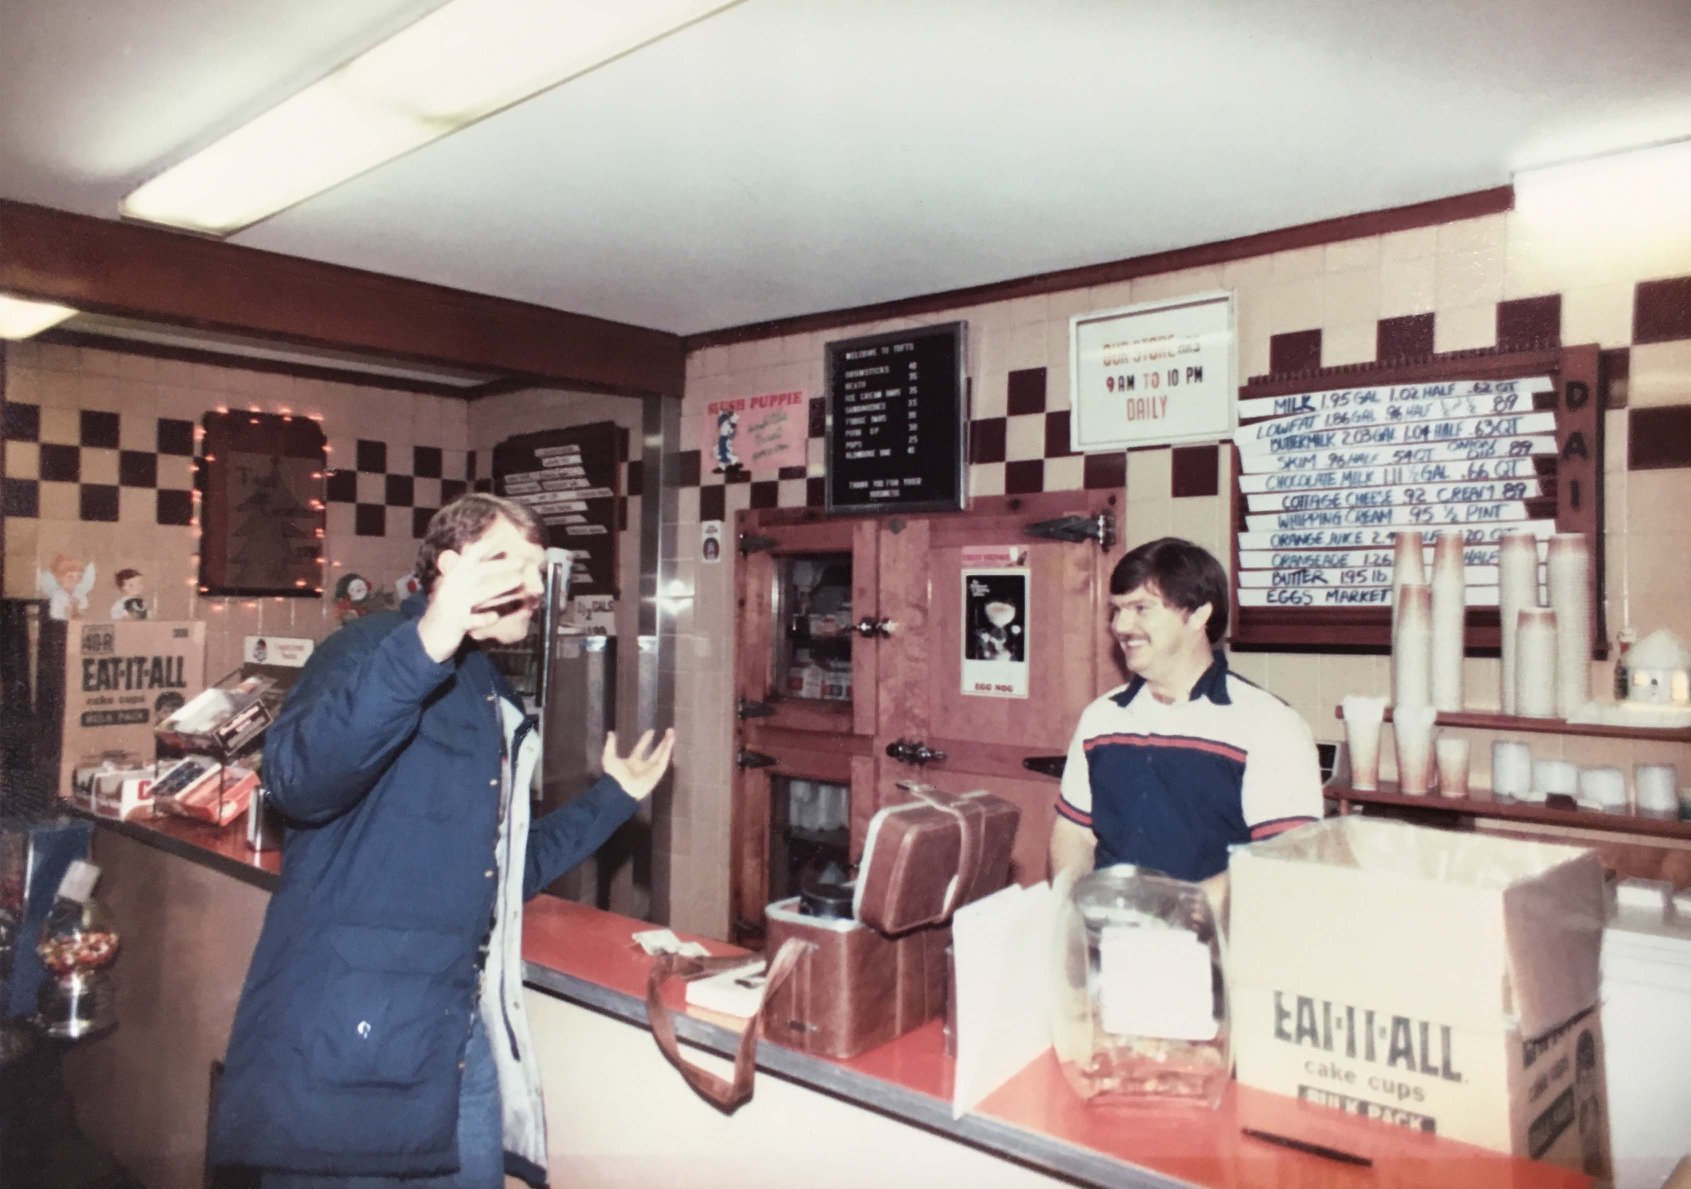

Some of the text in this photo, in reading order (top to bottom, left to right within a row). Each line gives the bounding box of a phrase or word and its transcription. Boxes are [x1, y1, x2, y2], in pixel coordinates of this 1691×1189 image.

[1143, 371, 1160, 389] TO
[1167, 369, 1179, 387] 10
[1186, 366, 1203, 384] PM
[750, 391, 802, 410] PUPPIE
[1127, 395, 1168, 421] DAILY
[1274, 395, 1315, 414] MILK
[1423, 383, 1456, 399] HALF
[1256, 413, 1320, 440] LOWFAT
[1434, 421, 1464, 438] HALF
[1277, 453, 1316, 471] SKIM
[1266, 471, 1336, 491] CHOCOLATE
[1341, 470, 1373, 485] MILK
[1282, 493, 1341, 511] COTTAGE
[1345, 489, 1393, 506] CHEESE
[1437, 484, 1496, 503] CREAM
[1278, 513, 1342, 529] WHIPPING
[1345, 508, 1393, 525] CREAM
[1465, 503, 1508, 521] PINT
[1270, 531, 1324, 549] ORANGE
[1326, 532, 1363, 547] JUICE
[1272, 552, 1348, 568] ORANGEADE
[1272, 568, 1328, 586] BUTTER
[1267, 588, 1393, 606] EGGS MARKET
[974, 682, 1014, 693] EGG NOG
[1304, 1059, 1426, 1103] cake cups
